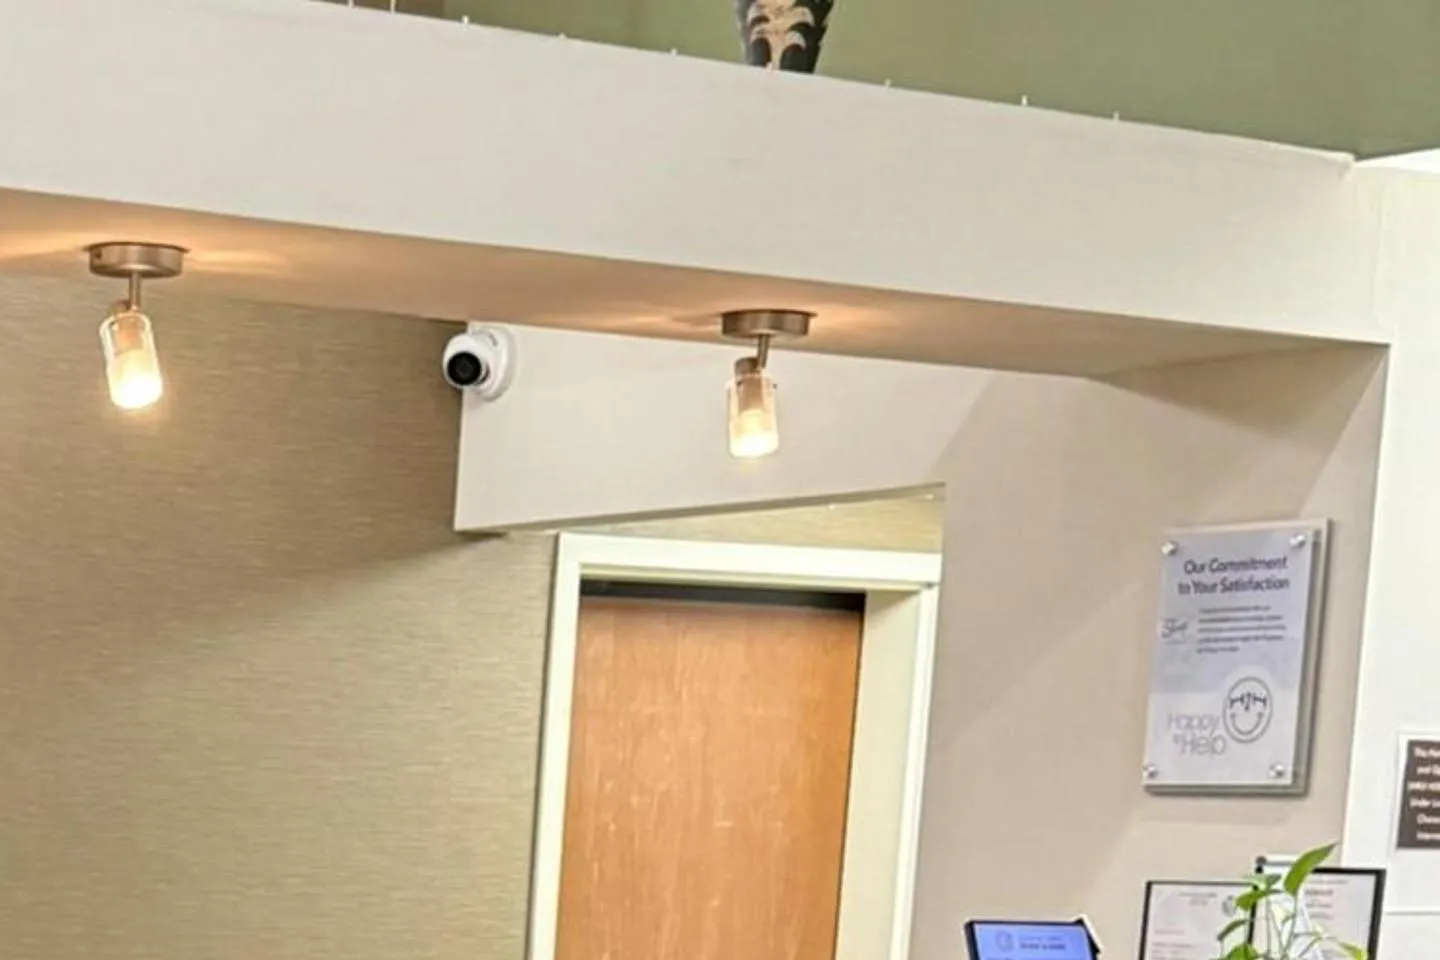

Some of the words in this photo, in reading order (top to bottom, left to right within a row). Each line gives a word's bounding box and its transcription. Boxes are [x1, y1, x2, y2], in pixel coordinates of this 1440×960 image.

[1184, 558, 1205, 575] Our
[1209, 556, 1289, 574] Commitment
[1178, 582, 1190, 595] to
[1192, 580, 1217, 594] Your
[1220, 575, 1290, 593] Satisfaction
